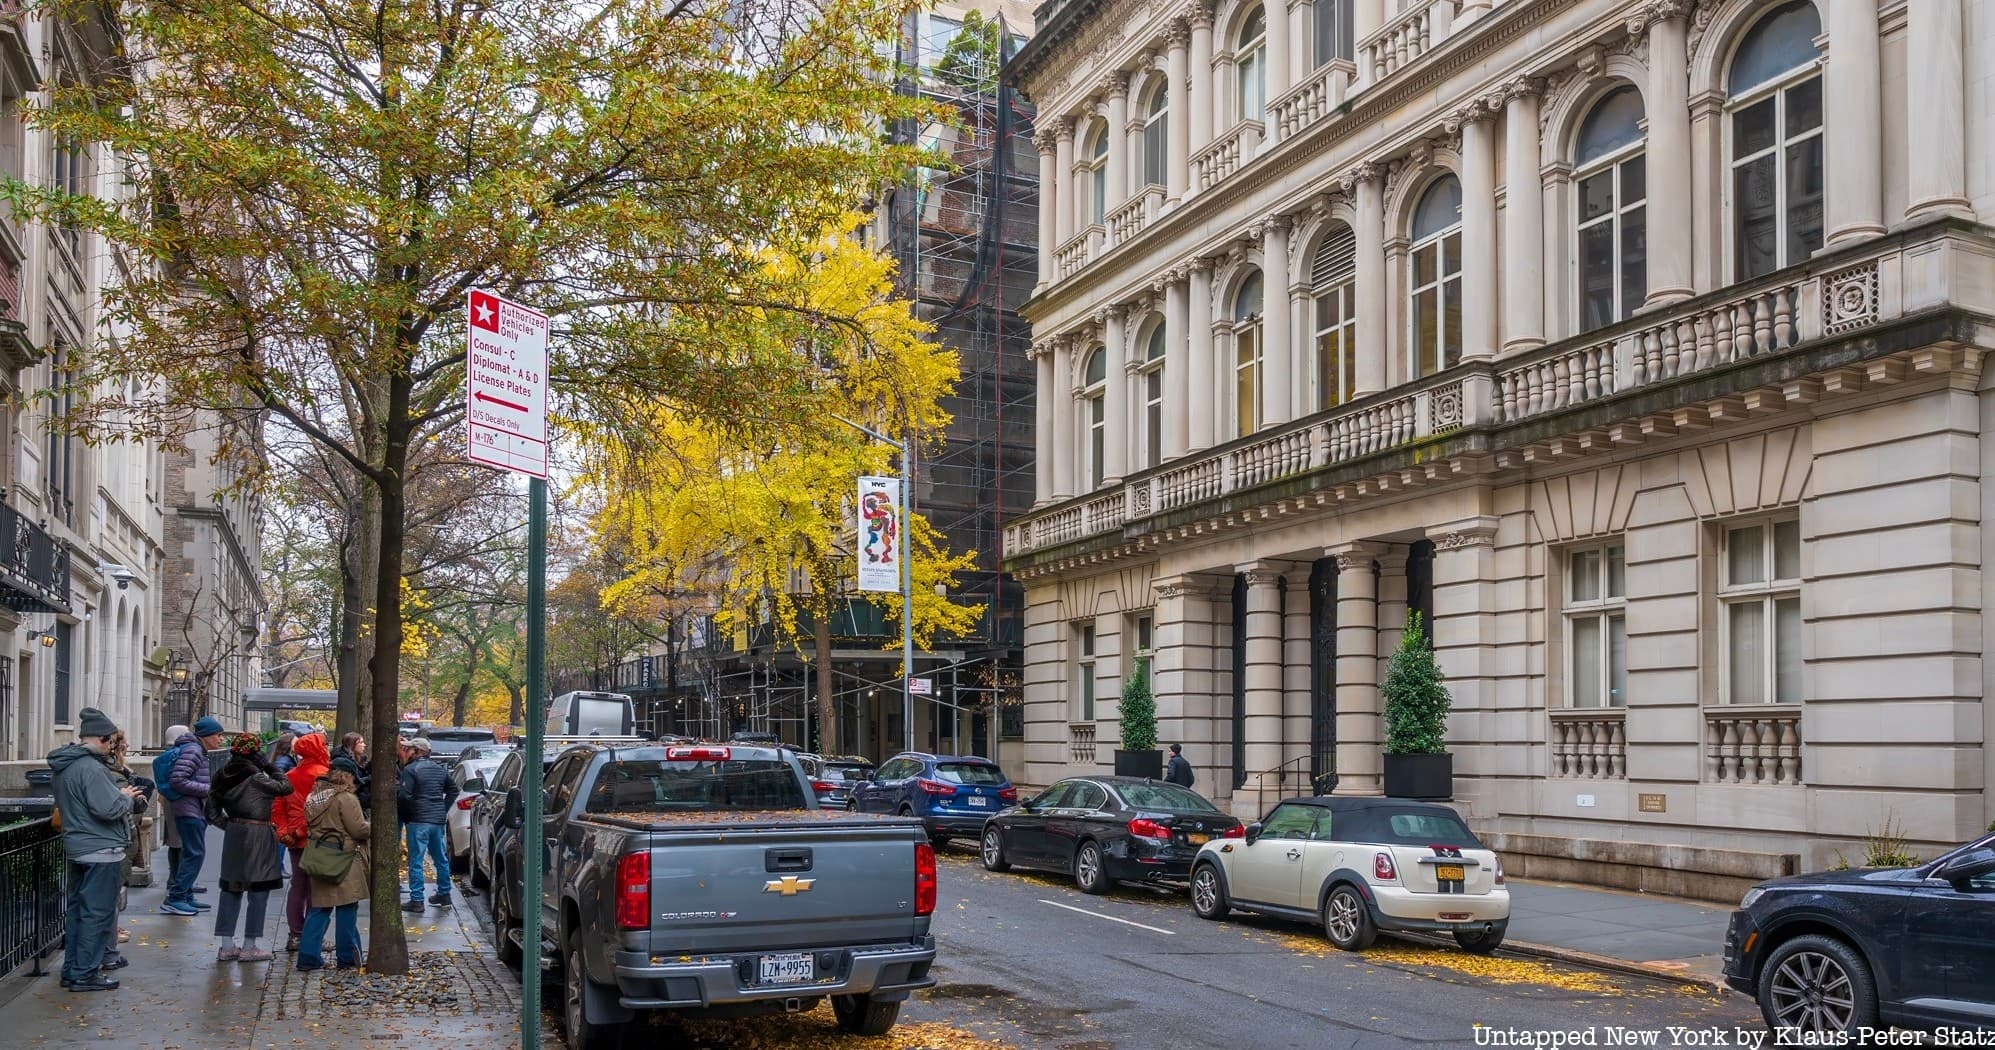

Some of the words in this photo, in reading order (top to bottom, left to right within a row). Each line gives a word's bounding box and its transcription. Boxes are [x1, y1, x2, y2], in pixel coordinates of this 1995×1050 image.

[501, 304, 545, 329] Authorized
[501, 315, 534, 336] Vehicles
[500, 326, 519, 343] Only
[473, 337, 502, 357] Consul
[509, 349, 516, 361] C
[473, 353, 510, 376] Diplomat
[517, 368, 524, 380] A
[525, 370, 531, 382] &
[533, 372, 539, 384] D
[473, 369, 505, 389] License
[507, 379, 532, 398] Plates
[472, 409, 484, 420] D/S
[485, 412, 506, 427] Decals
[506, 419, 520, 432] Only
[661, 911, 717, 920] COLORADO
